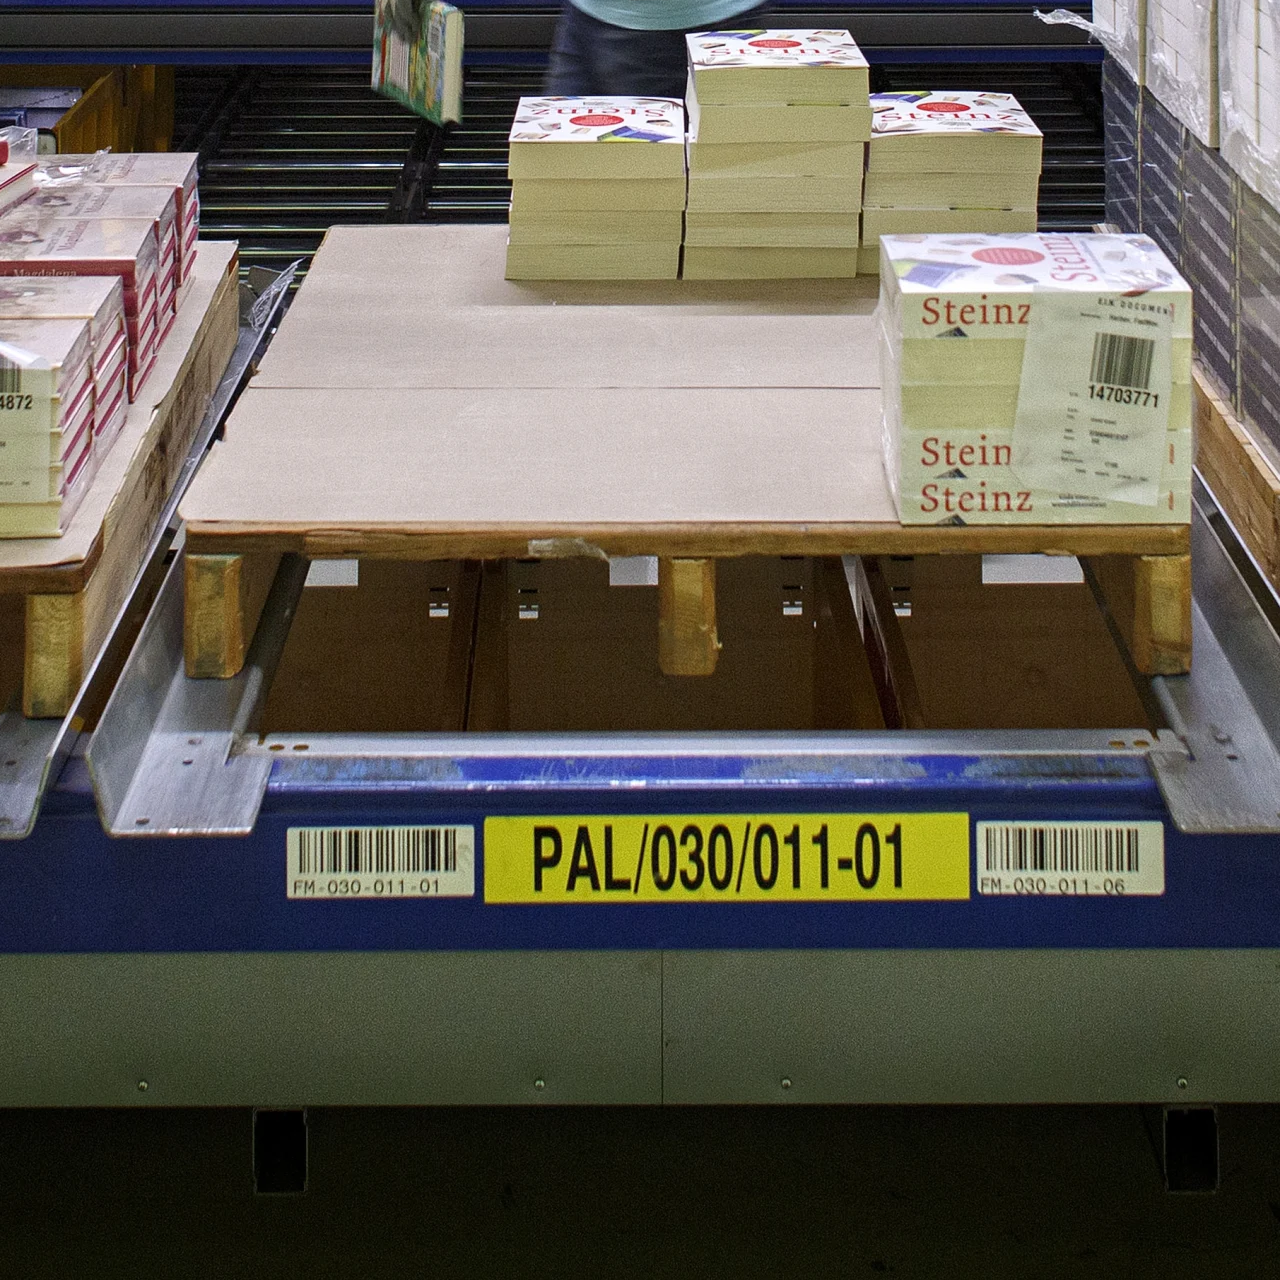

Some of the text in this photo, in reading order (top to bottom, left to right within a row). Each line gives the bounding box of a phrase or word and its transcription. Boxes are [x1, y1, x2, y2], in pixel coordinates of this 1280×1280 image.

[1039, 235, 1098, 283] Steinz
[922, 294, 1031, 325] Steinz
[1120, 300, 1168, 315] DOCUMEN
[1088, 385, 1159, 408] 14703771
[921, 434, 1012, 466] Stein
[920, 481, 1033, 512] Steinz
[533, 822, 903, 894] PAL/030/011-01
[292, 878, 440, 896] FM-030-011-01
[980, 876, 1126, 895] FM-030-011-06
